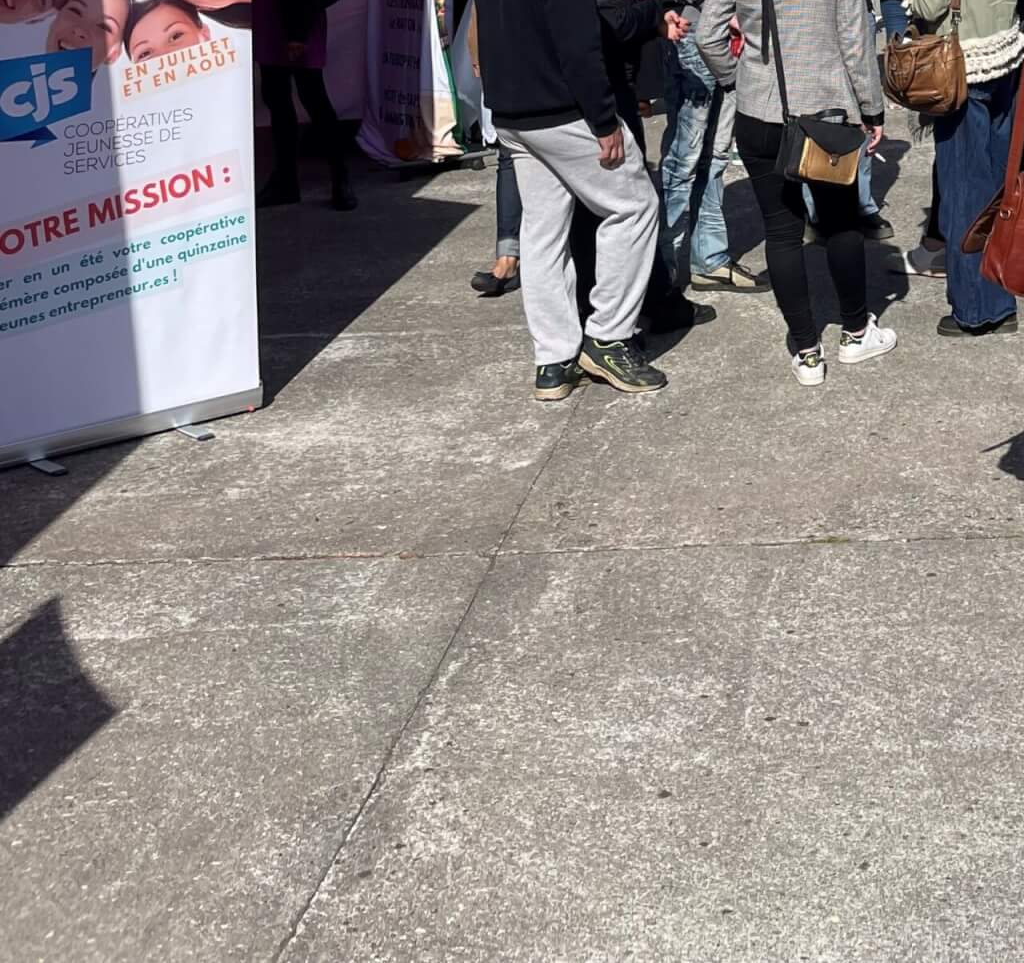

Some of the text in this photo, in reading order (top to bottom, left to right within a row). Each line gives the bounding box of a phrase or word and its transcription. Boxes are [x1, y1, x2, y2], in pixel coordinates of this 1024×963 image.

[123, 50, 236, 97] ET EN AOÛT
[125, 37, 231, 81] EN JUILLET
[1, 62, 79, 123] cjs
[63, 107, 193, 139] COOPÉRATIVES
[63, 127, 181, 158] JEUNESSE DE
[63, 149, 146, 175] SERVICES
[0, 208, 80, 255] OTRE
[88, 165, 214, 229] MISSION
[23, 272, 42, 284] en
[51, 262, 70, 277] un
[80, 252, 104, 268] été
[113, 240, 151, 258] votre
[160, 214, 245, 246] coopérative
[54, 266, 129, 296] composée
[132, 253, 174, 274] d'une
[178, 232, 248, 263] quinzaine
[0, 311, 46, 332] eunes
[49, 274, 170, 319] entrepreneur.es
